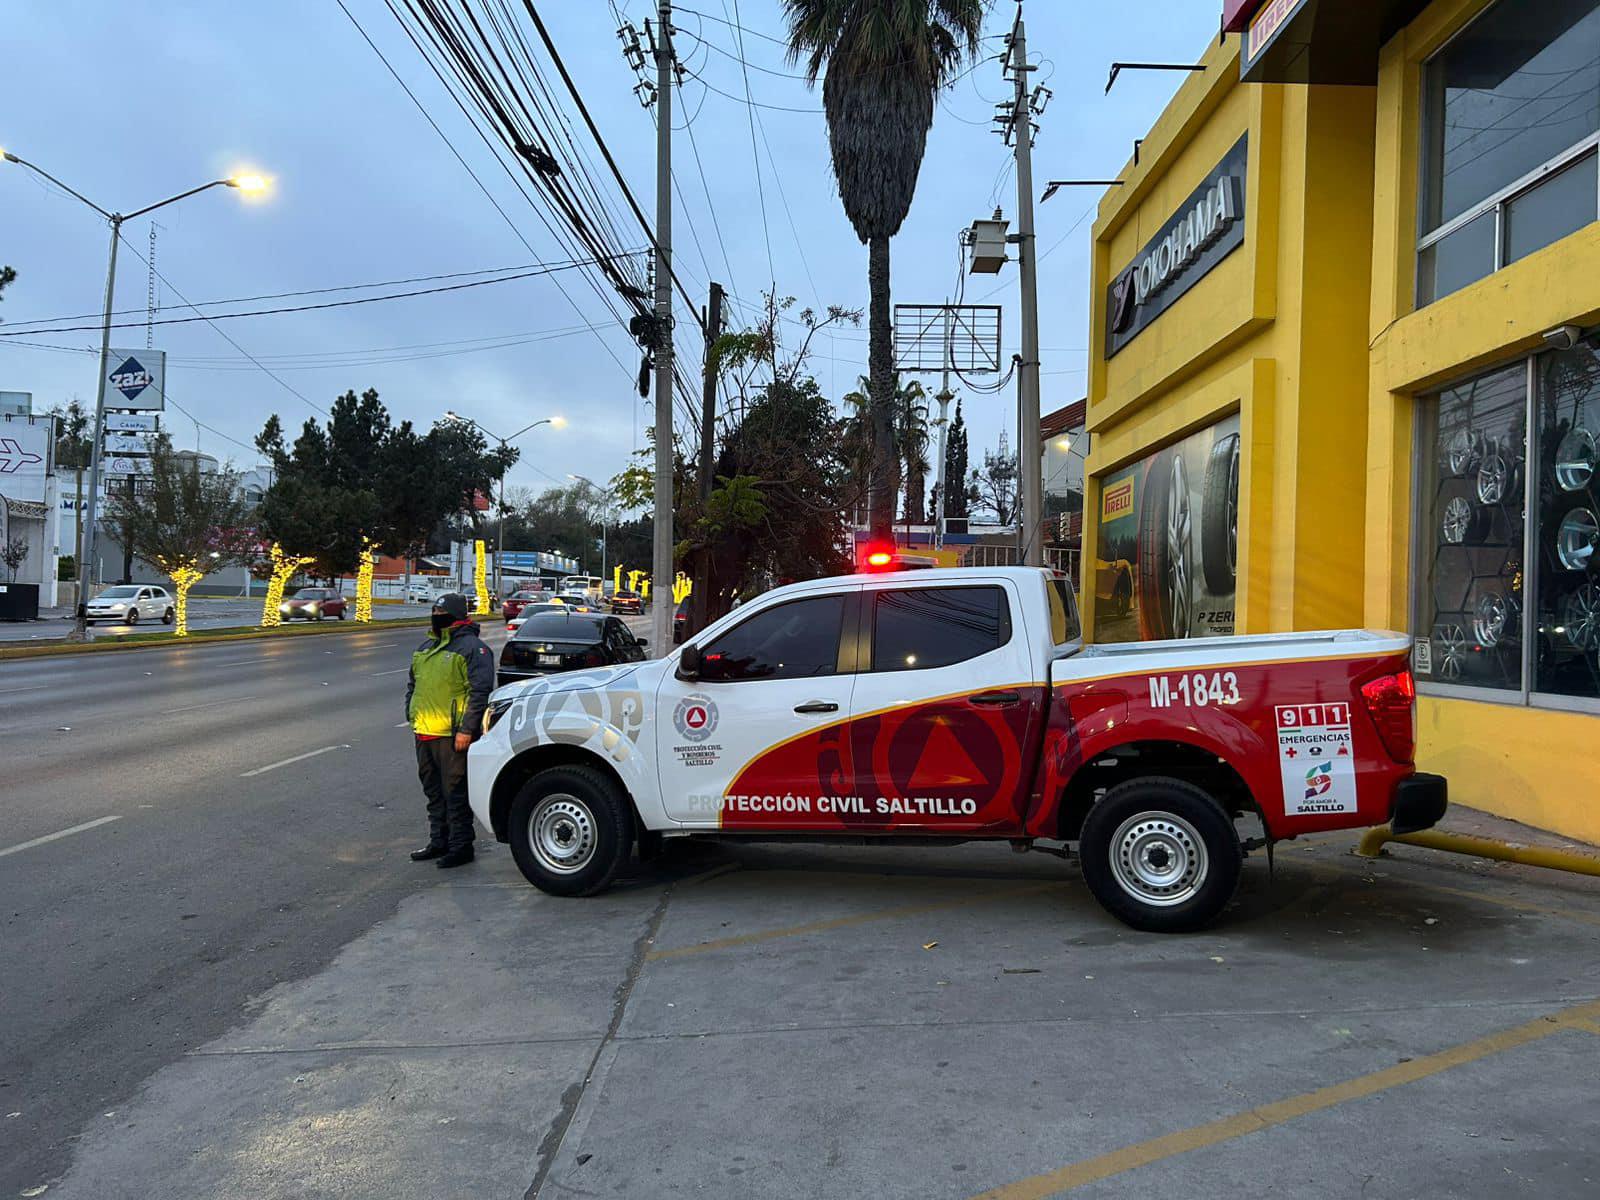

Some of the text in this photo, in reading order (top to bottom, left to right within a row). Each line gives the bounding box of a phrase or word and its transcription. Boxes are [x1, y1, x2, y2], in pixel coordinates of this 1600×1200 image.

[1134, 176, 1234, 306] YOKOHAMA
[1105, 484, 1131, 515] PIRELLI
[1197, 612, 1206, 623] P
[1149, 672, 1239, 708] M-1843
[1280, 733, 1350, 744] EMERGENCIAS
[673, 744, 706, 752] PROTECCIÓN
[688, 792, 977, 815] PROTECCIÓN CIVIL SALTILLO
[1297, 804, 1344, 813] SALTILLO
